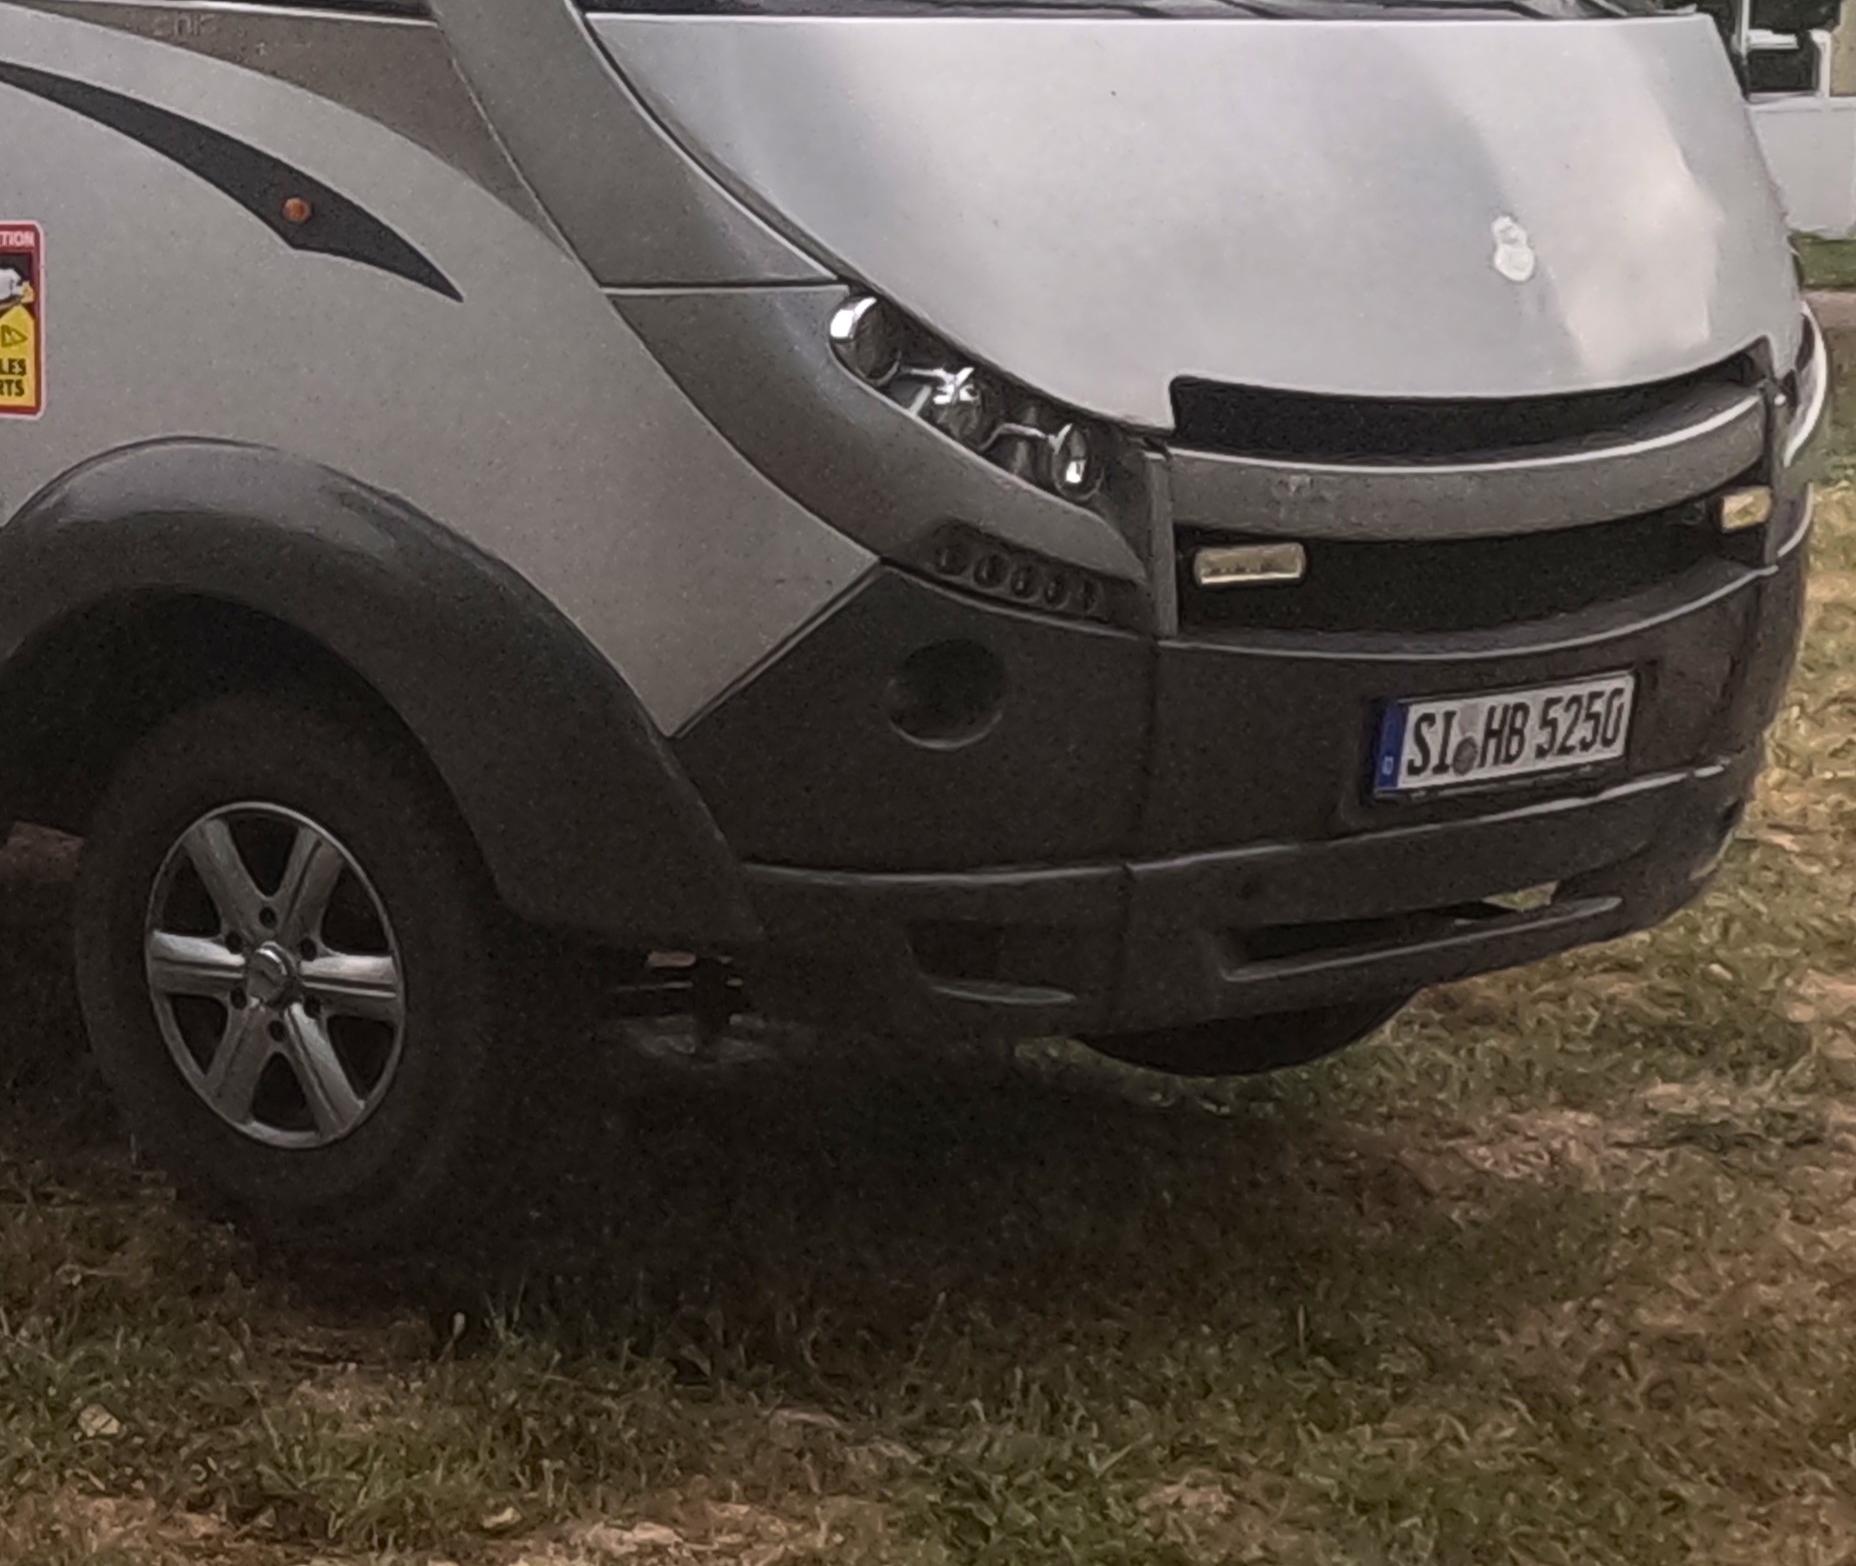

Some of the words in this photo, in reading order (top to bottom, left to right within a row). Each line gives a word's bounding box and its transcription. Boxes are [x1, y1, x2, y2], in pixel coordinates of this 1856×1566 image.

[1406, 710, 1458, 777] SI
[1478, 701, 1531, 769] HB
[1535, 687, 1625, 760] 5250
